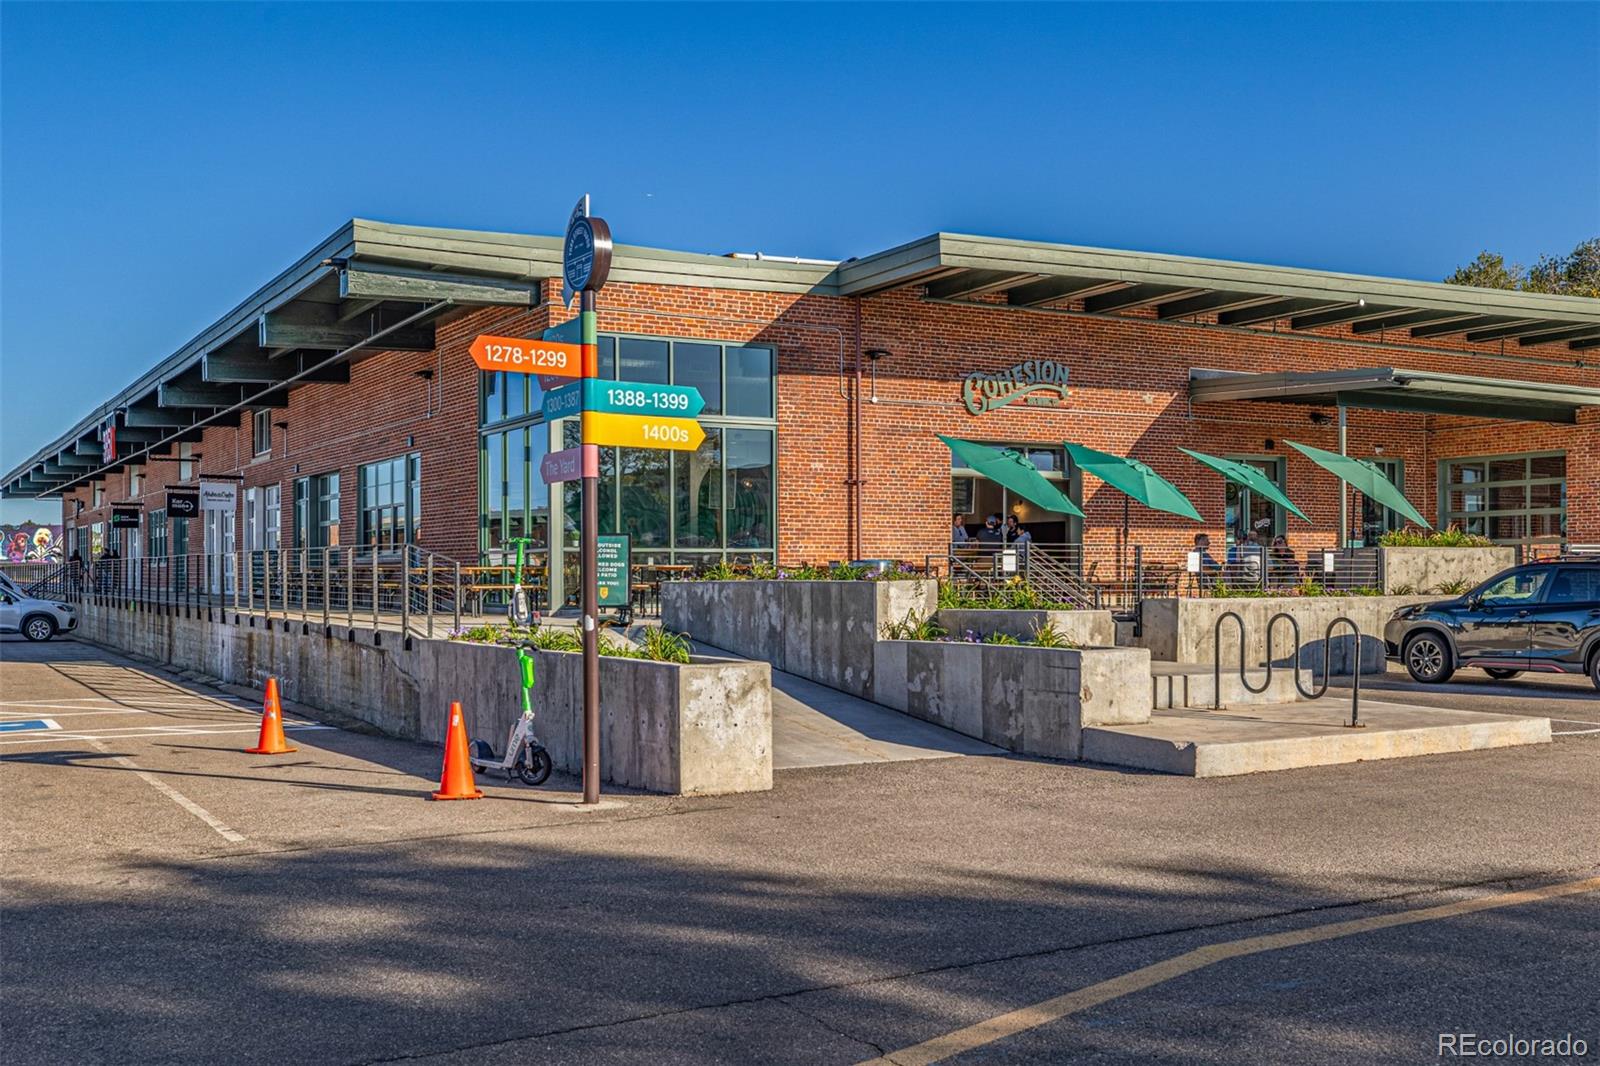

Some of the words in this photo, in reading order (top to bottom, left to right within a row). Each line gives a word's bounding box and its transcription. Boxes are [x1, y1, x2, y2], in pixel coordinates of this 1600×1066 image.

[484, 345, 567, 368] 1278-1299
[963, 360, 1069, 415] COHESION
[607, 389, 689, 410] 1388-1399
[641, 424, 689, 442] 1400s
[545, 460, 559, 475] The
[559, 456, 575, 473] Yard
